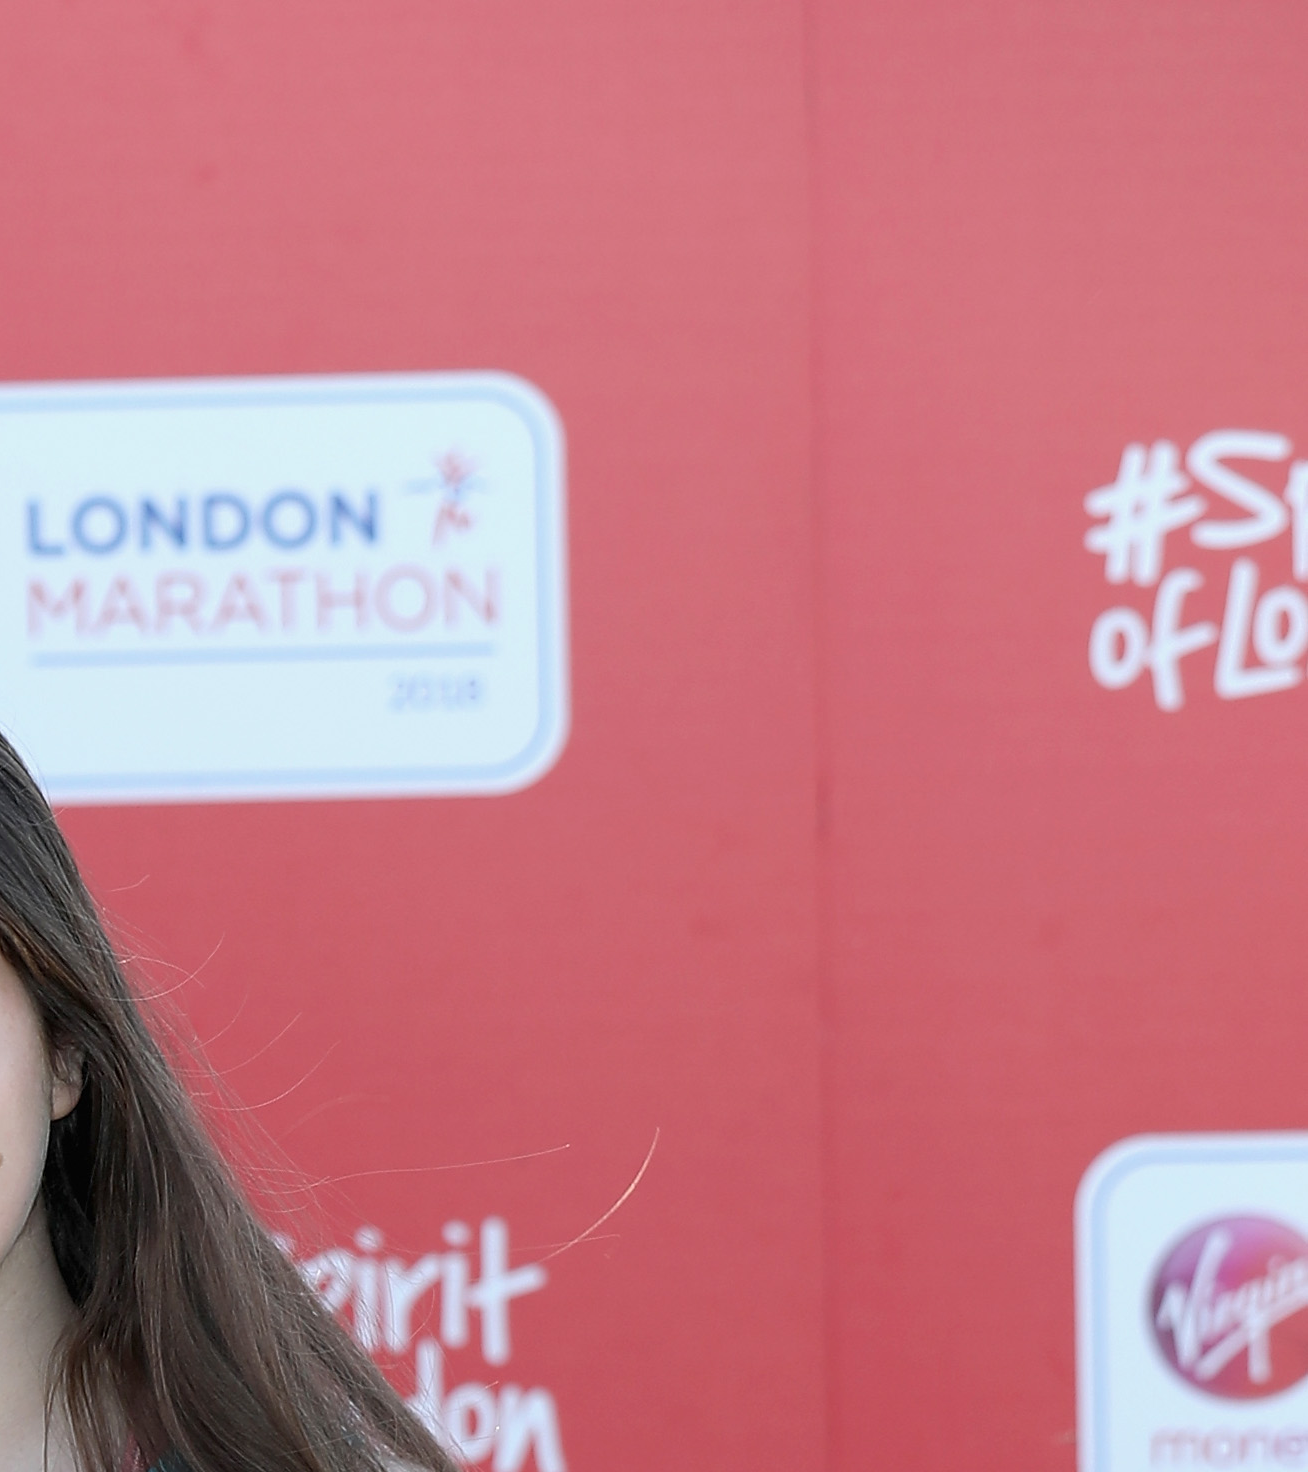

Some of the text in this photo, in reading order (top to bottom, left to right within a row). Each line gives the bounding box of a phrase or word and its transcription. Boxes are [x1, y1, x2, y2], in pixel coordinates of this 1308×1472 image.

[25, 488, 379, 557] LONDON
[26, 568, 502, 639] MARATHON
[1089, 566, 1217, 713] of
[387, 674, 484, 712] 2018
